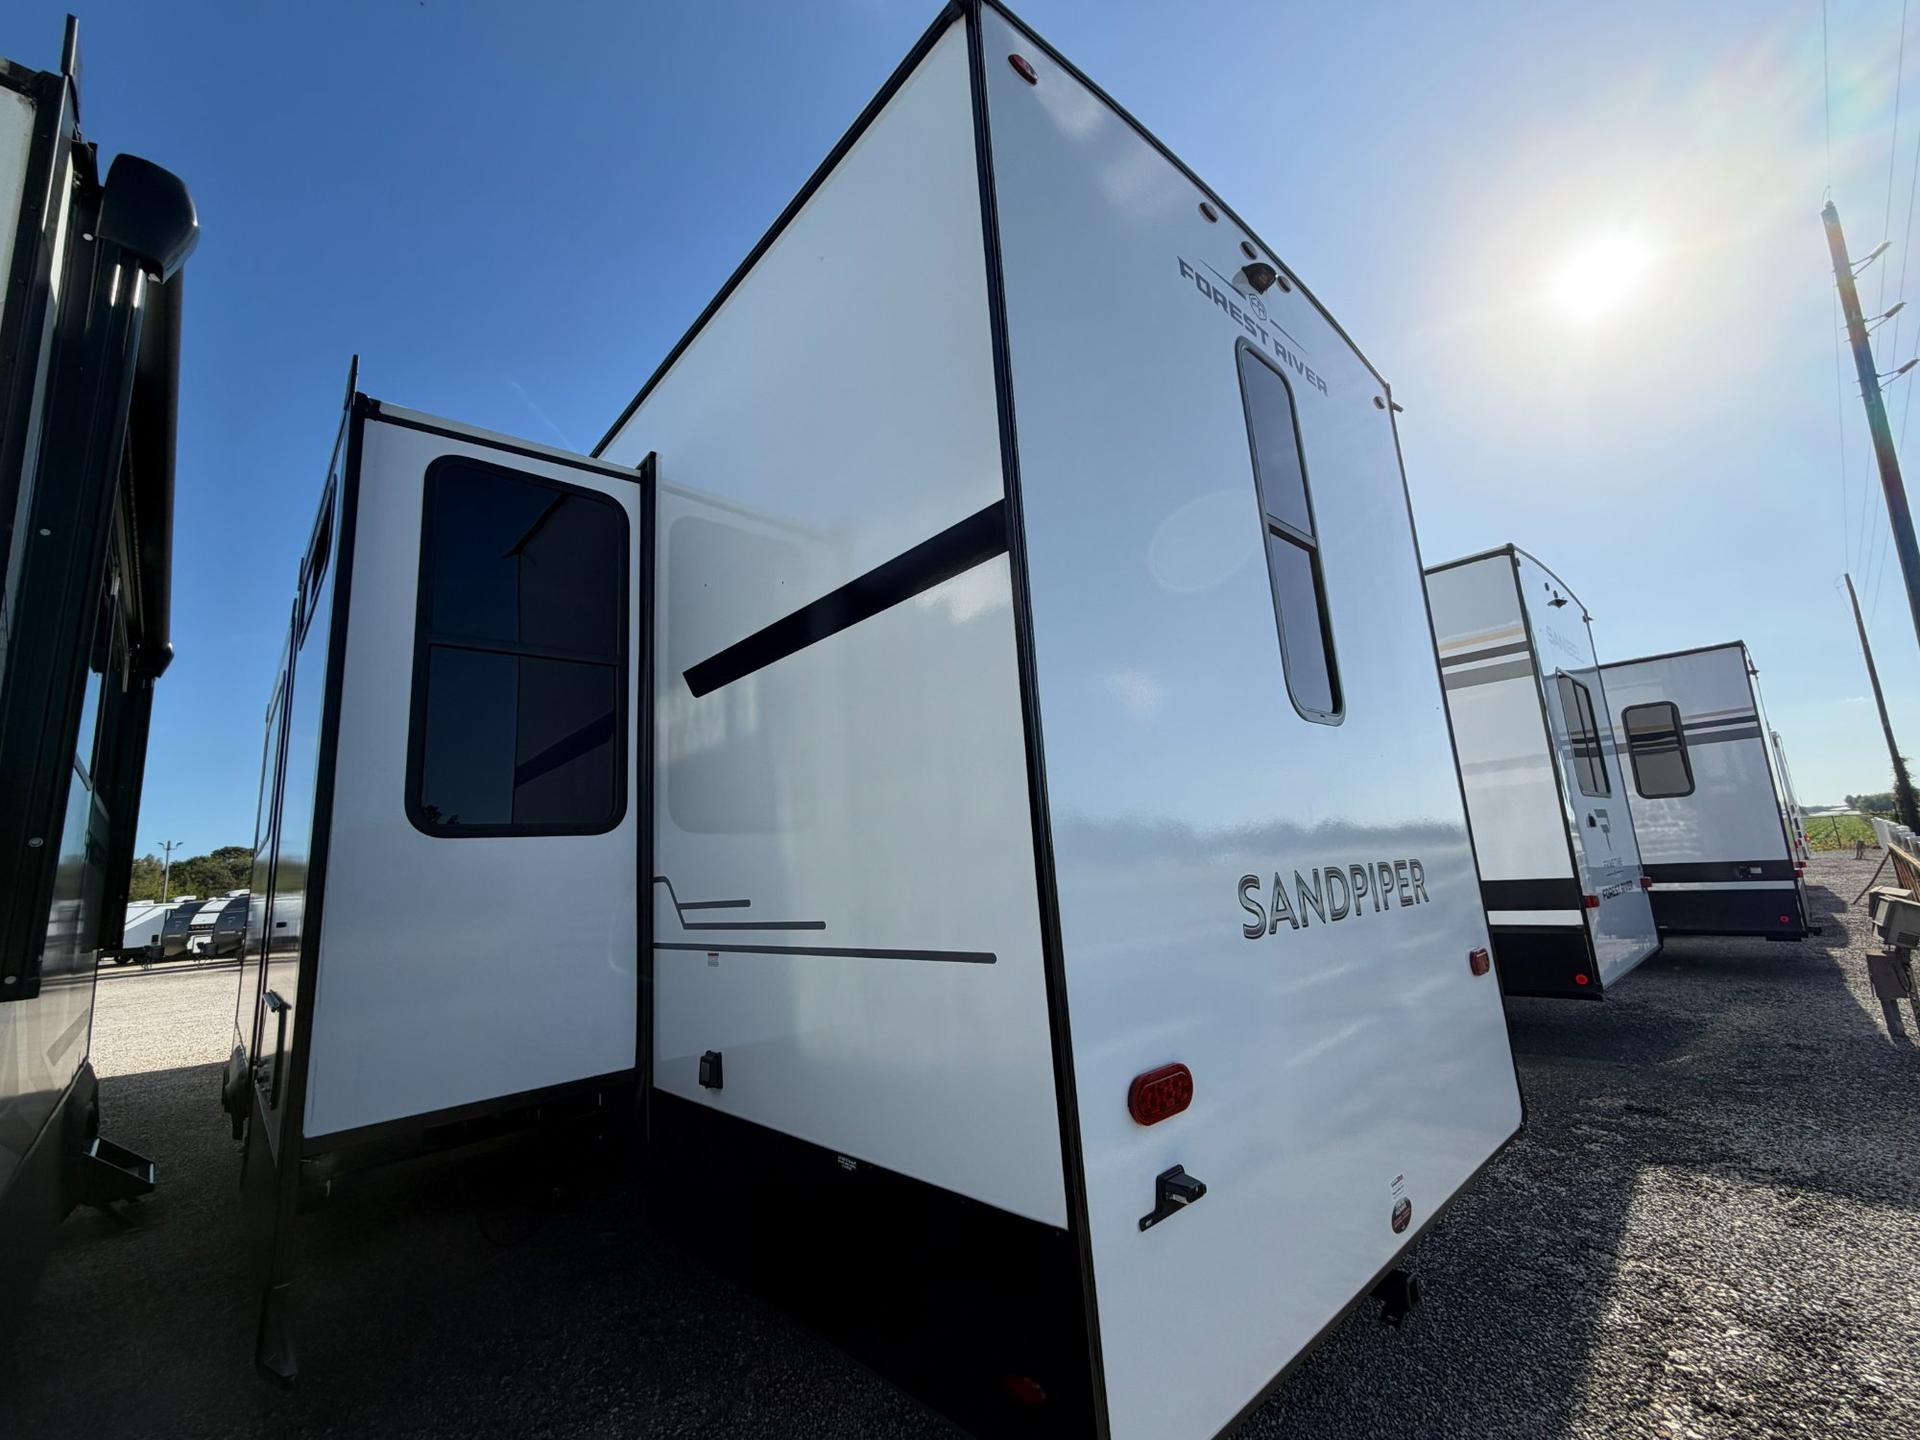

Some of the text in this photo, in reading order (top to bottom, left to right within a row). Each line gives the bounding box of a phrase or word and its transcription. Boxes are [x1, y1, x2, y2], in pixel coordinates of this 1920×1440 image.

[1177, 255, 1328, 397] FOREST RIVER
[1237, 858, 1430, 939] SANDPIPER
